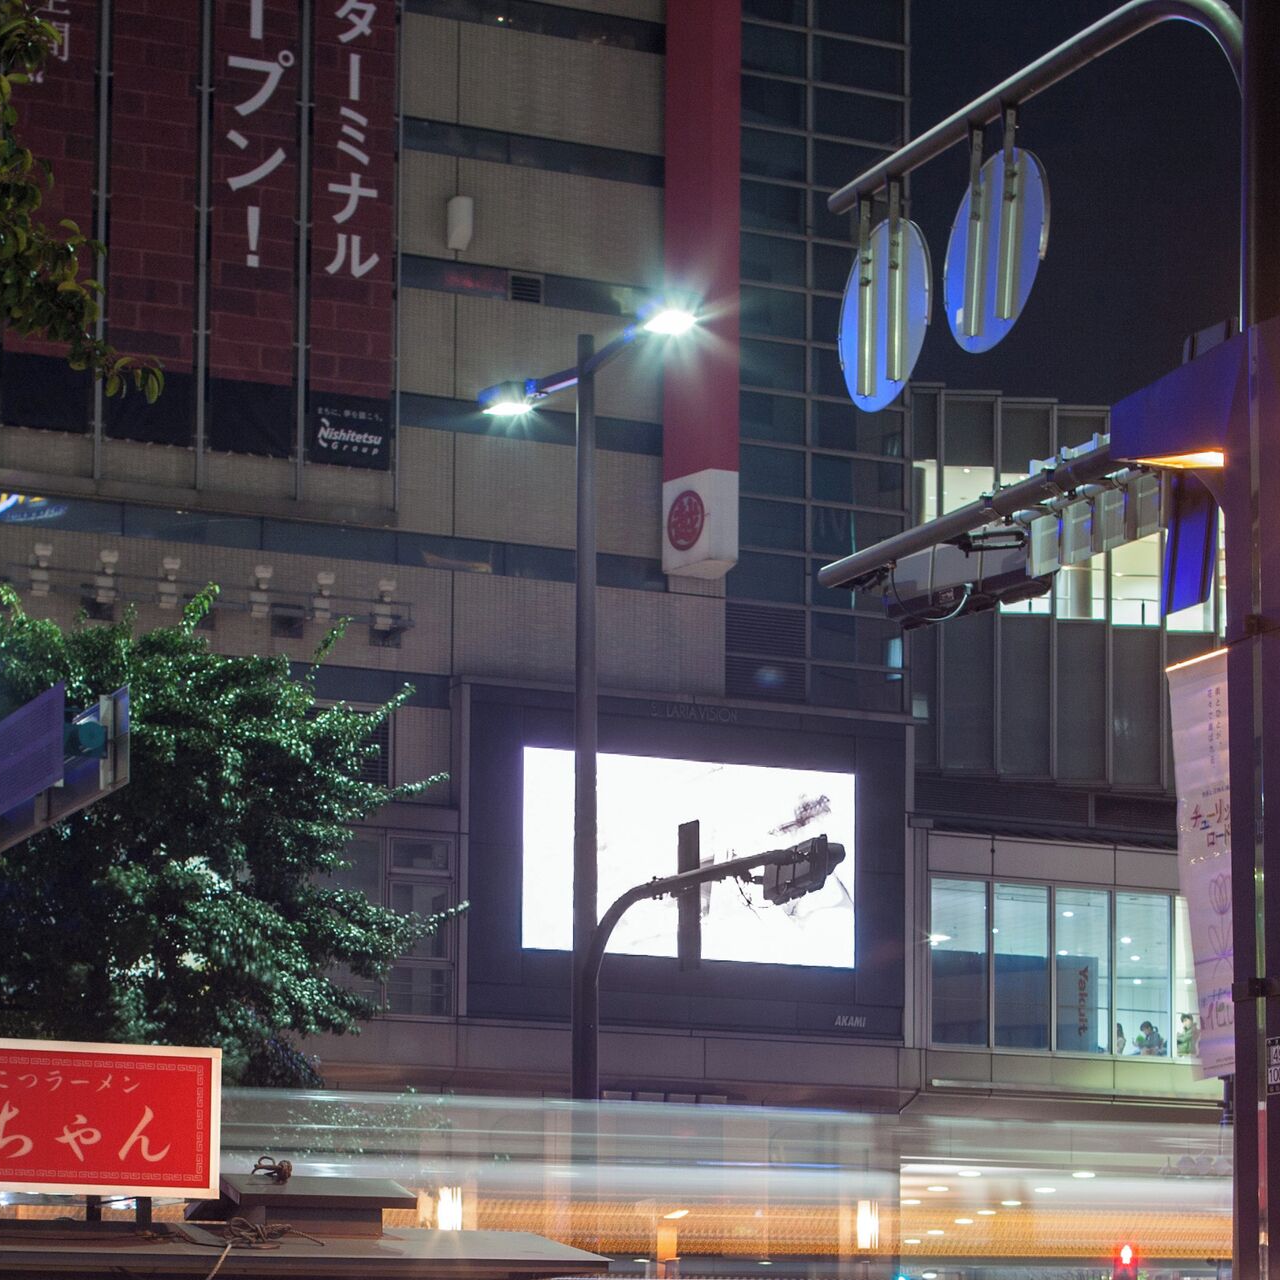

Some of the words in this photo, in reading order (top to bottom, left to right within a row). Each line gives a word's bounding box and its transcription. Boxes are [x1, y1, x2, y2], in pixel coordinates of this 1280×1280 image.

[324, 0, 380, 279] ターミナル
[317, 426, 382, 446] Nishitetsu
[331, 441, 380, 456] Group
